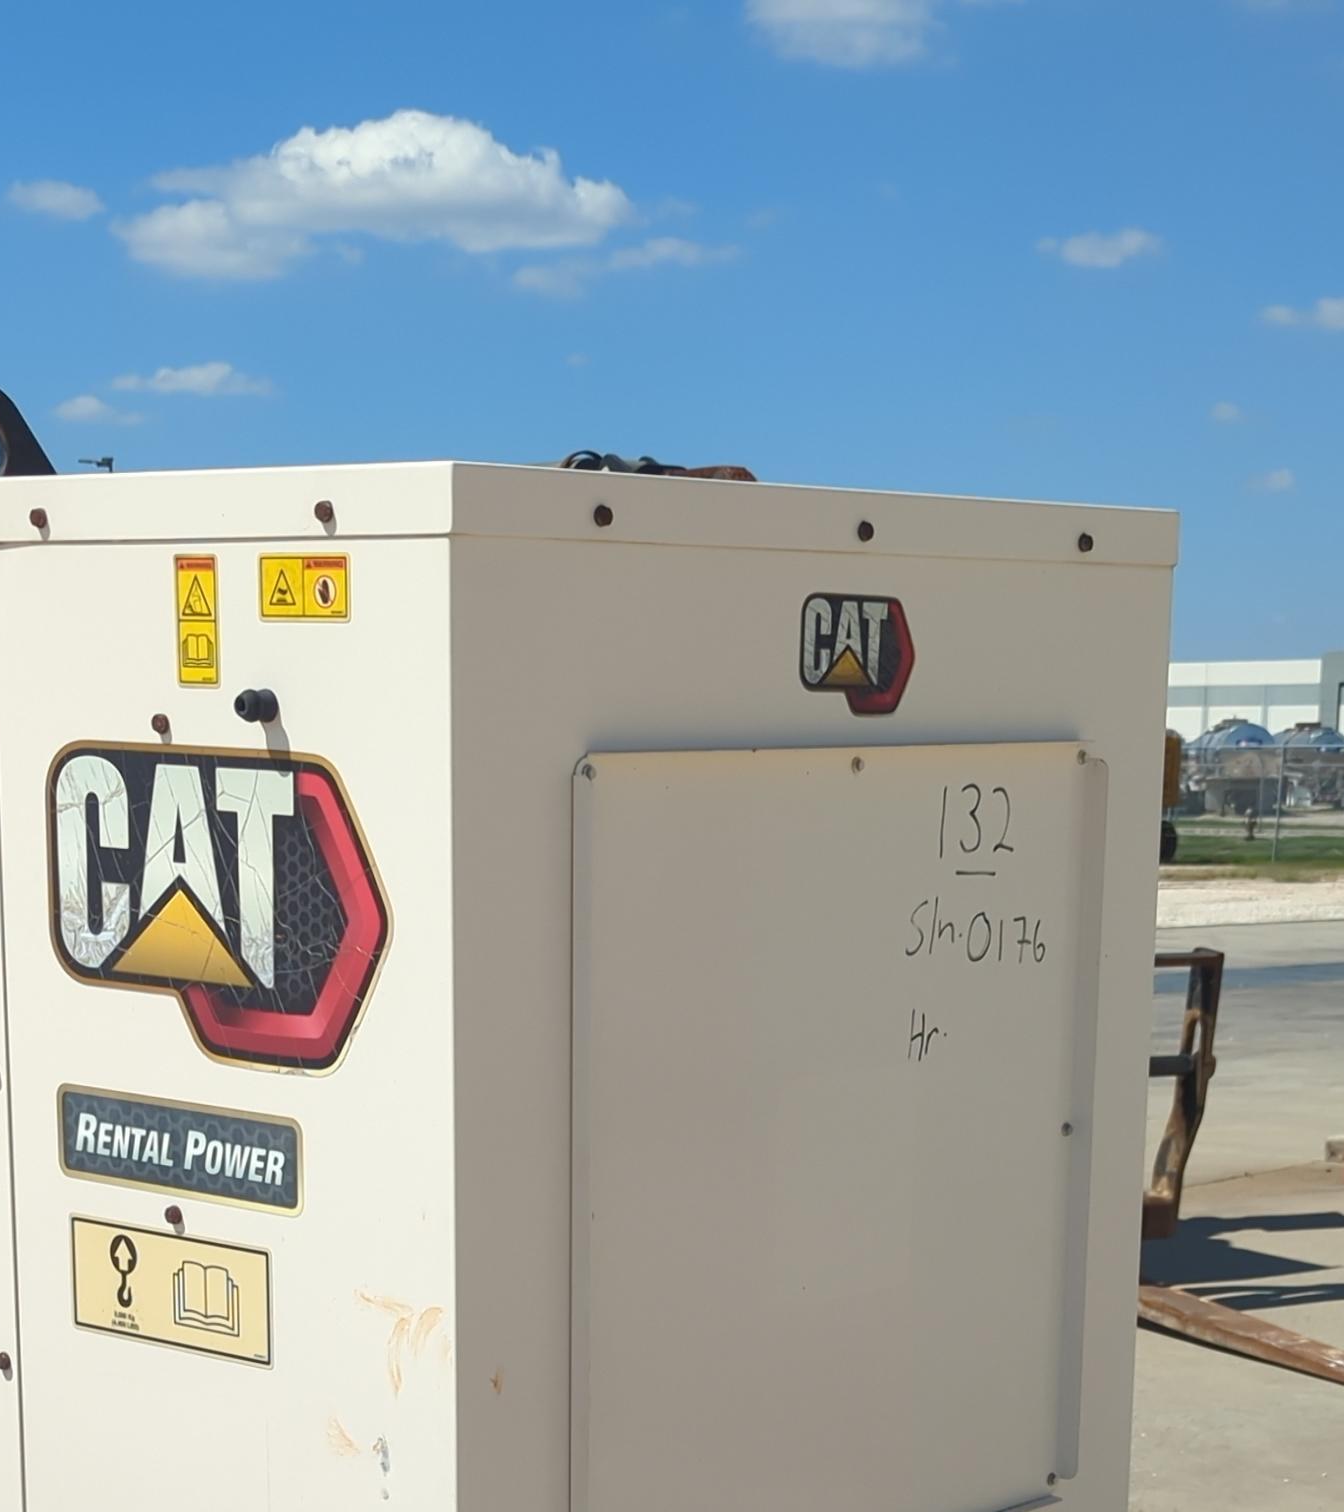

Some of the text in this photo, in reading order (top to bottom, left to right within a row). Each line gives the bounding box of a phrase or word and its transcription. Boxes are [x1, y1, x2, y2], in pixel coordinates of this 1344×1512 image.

[804, 598, 888, 686] CAT
[939, 783, 1014, 859] 132
[56, 755, 295, 989] CAT
[75, 1112, 286, 1186] RENTAL POWER
